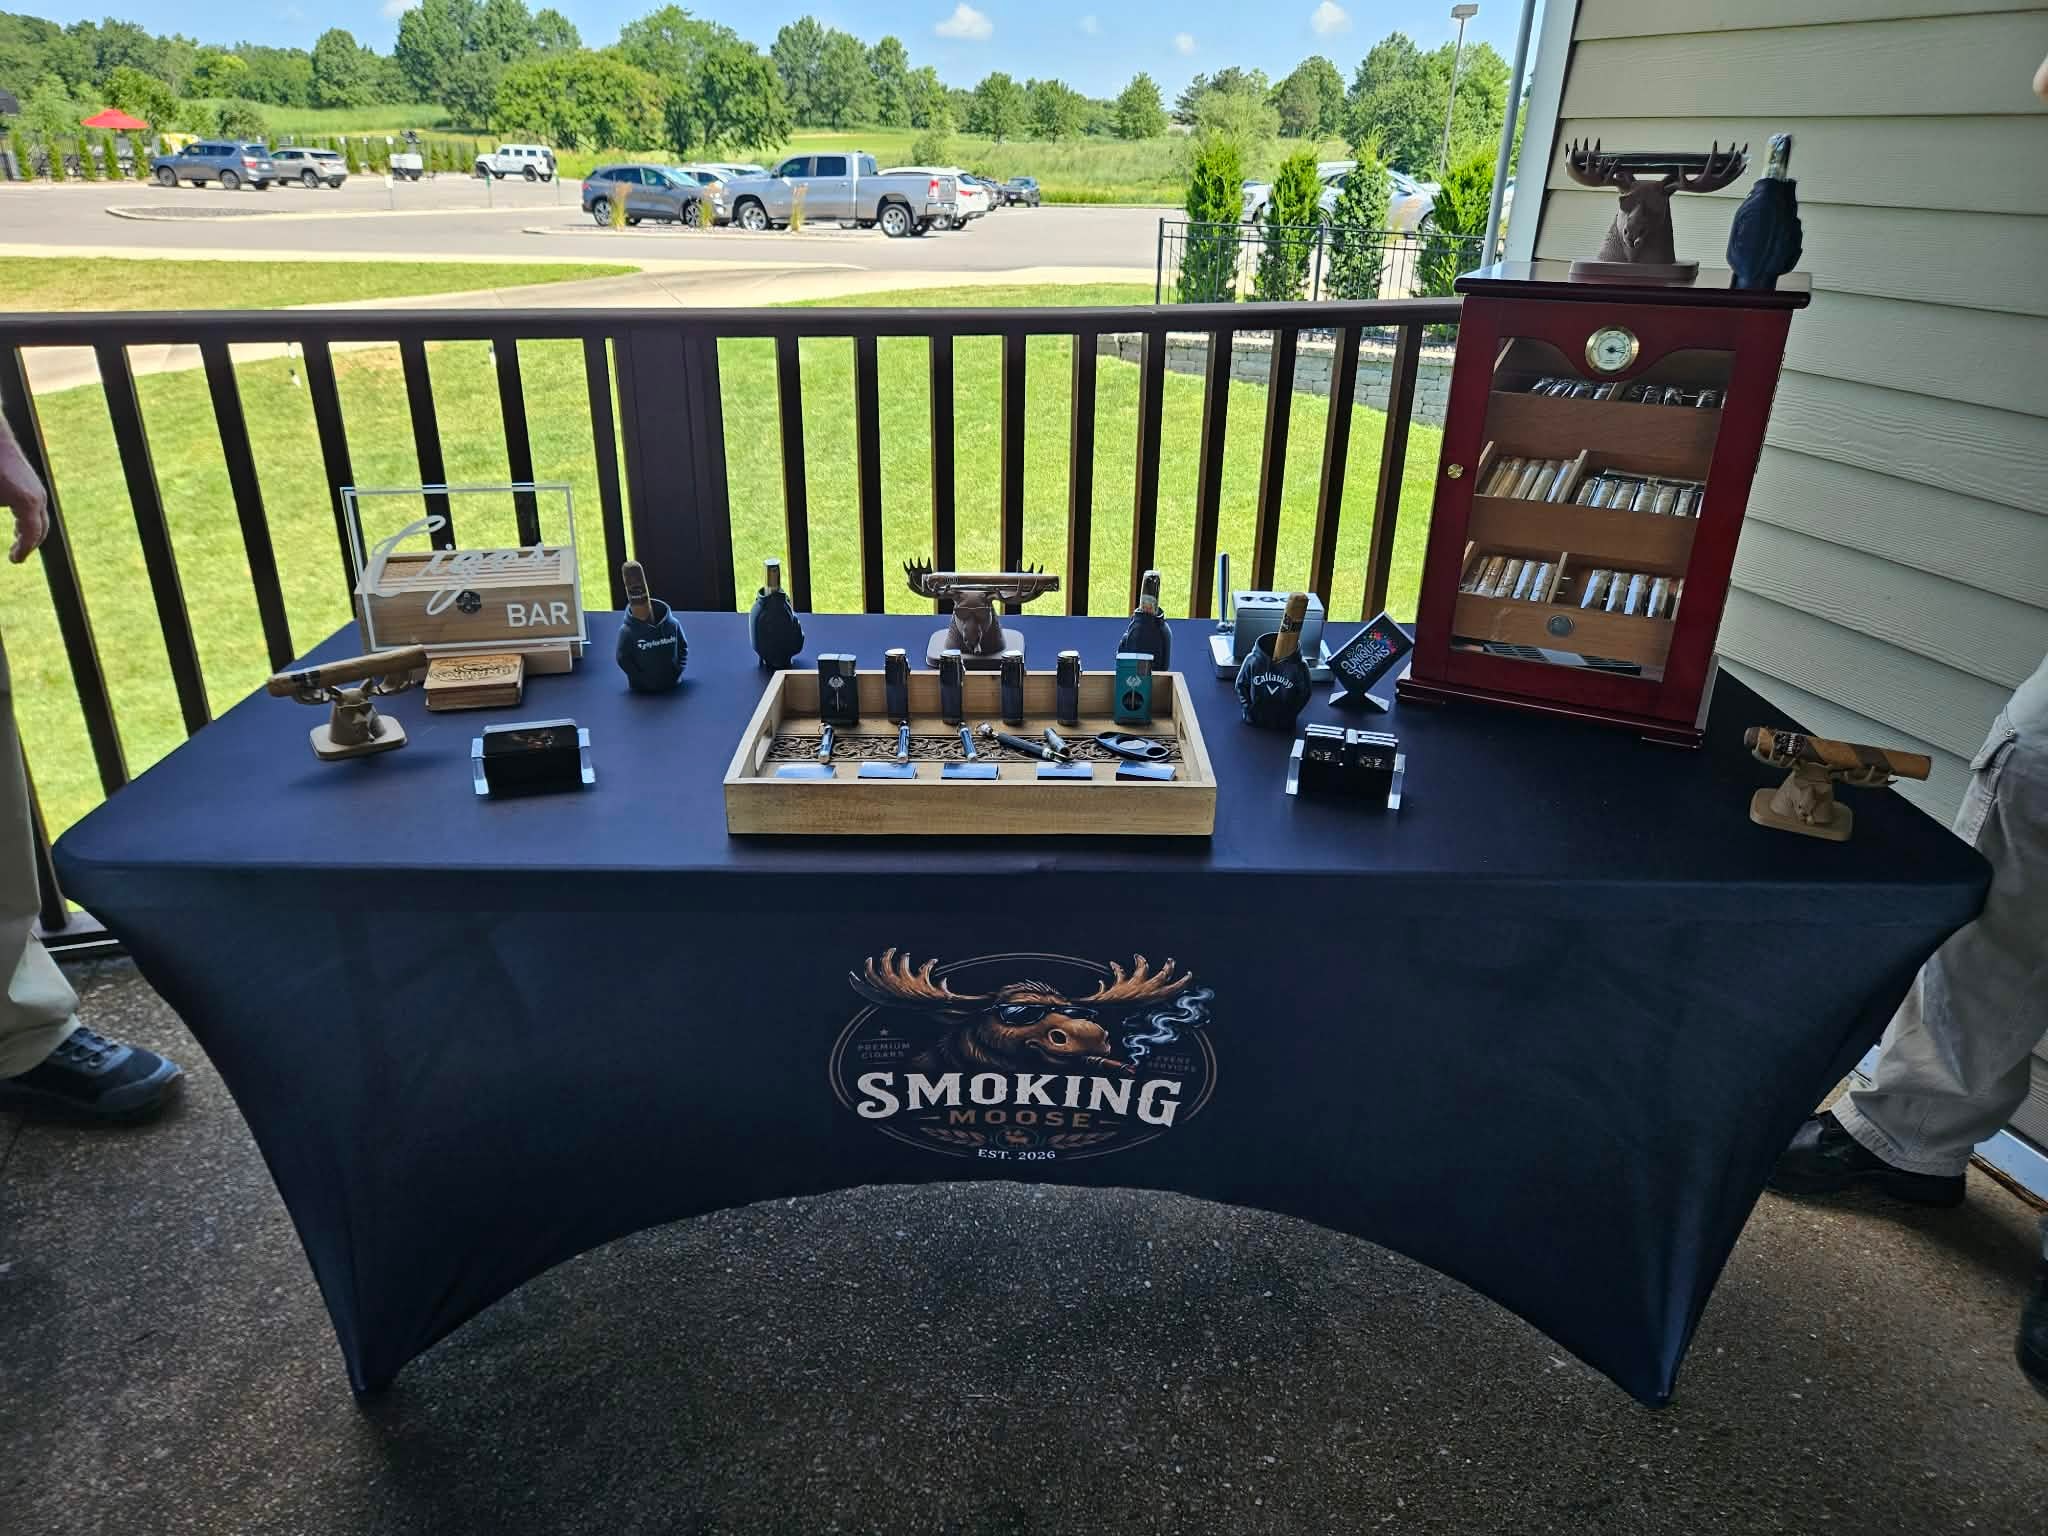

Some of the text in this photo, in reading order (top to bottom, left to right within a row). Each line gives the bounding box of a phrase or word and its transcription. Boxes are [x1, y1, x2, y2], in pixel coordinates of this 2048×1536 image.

[362, 515, 562, 616] Cigars
[506, 602, 571, 628] BAR
[1341, 640, 1381, 669] UNIQUE
[1347, 646, 1390, 679] VISIONS
[1253, 672, 1294, 689] Callaway
[857, 1042, 911, 1052] PREMIUM
[857, 1071, 1182, 1128] SMOKING
[949, 1109, 1093, 1129] MOOSE
[978, 1148, 1056, 1161] EST. 2026
